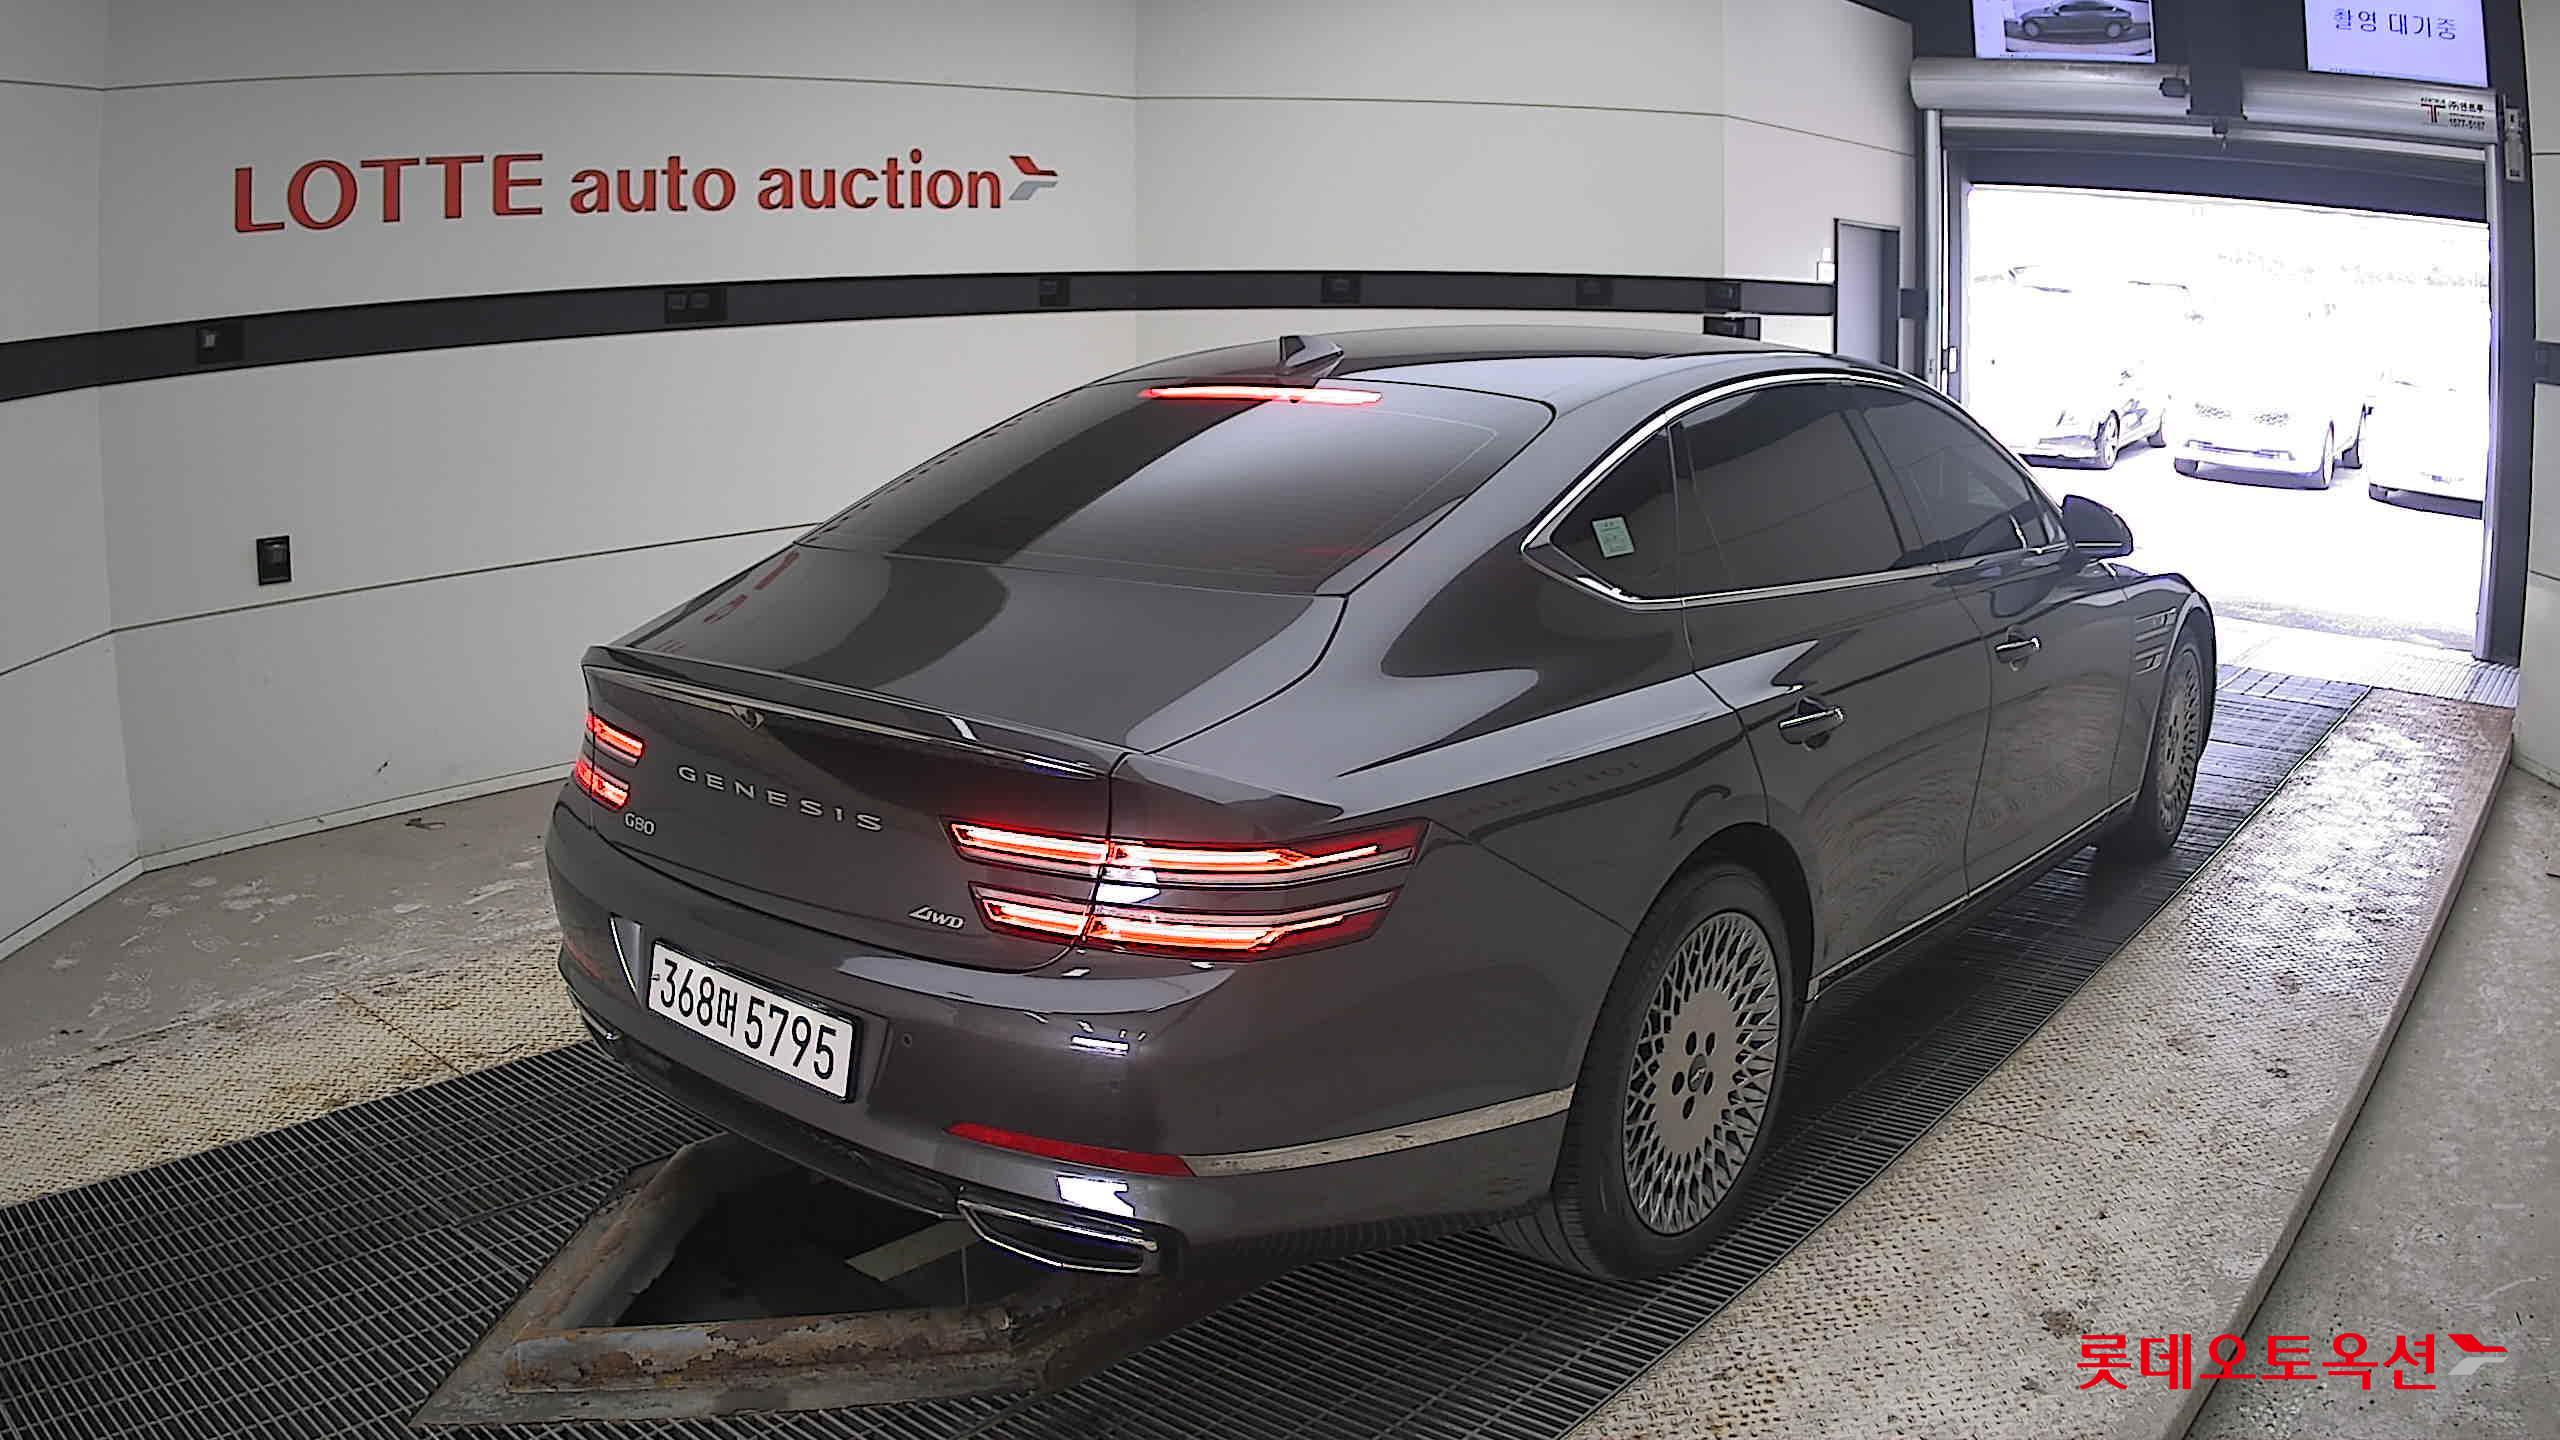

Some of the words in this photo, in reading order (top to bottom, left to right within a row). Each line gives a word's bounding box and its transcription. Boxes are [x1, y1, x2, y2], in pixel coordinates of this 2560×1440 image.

[2389, 13, 2457, 40] 대기중
[234, 153, 542, 234] LOTTE
[569, 156, 737, 214] auto
[757, 148, 1003, 211] auction
[678, 765, 883, 832] GENESIS
[625, 812, 655, 835] G80
